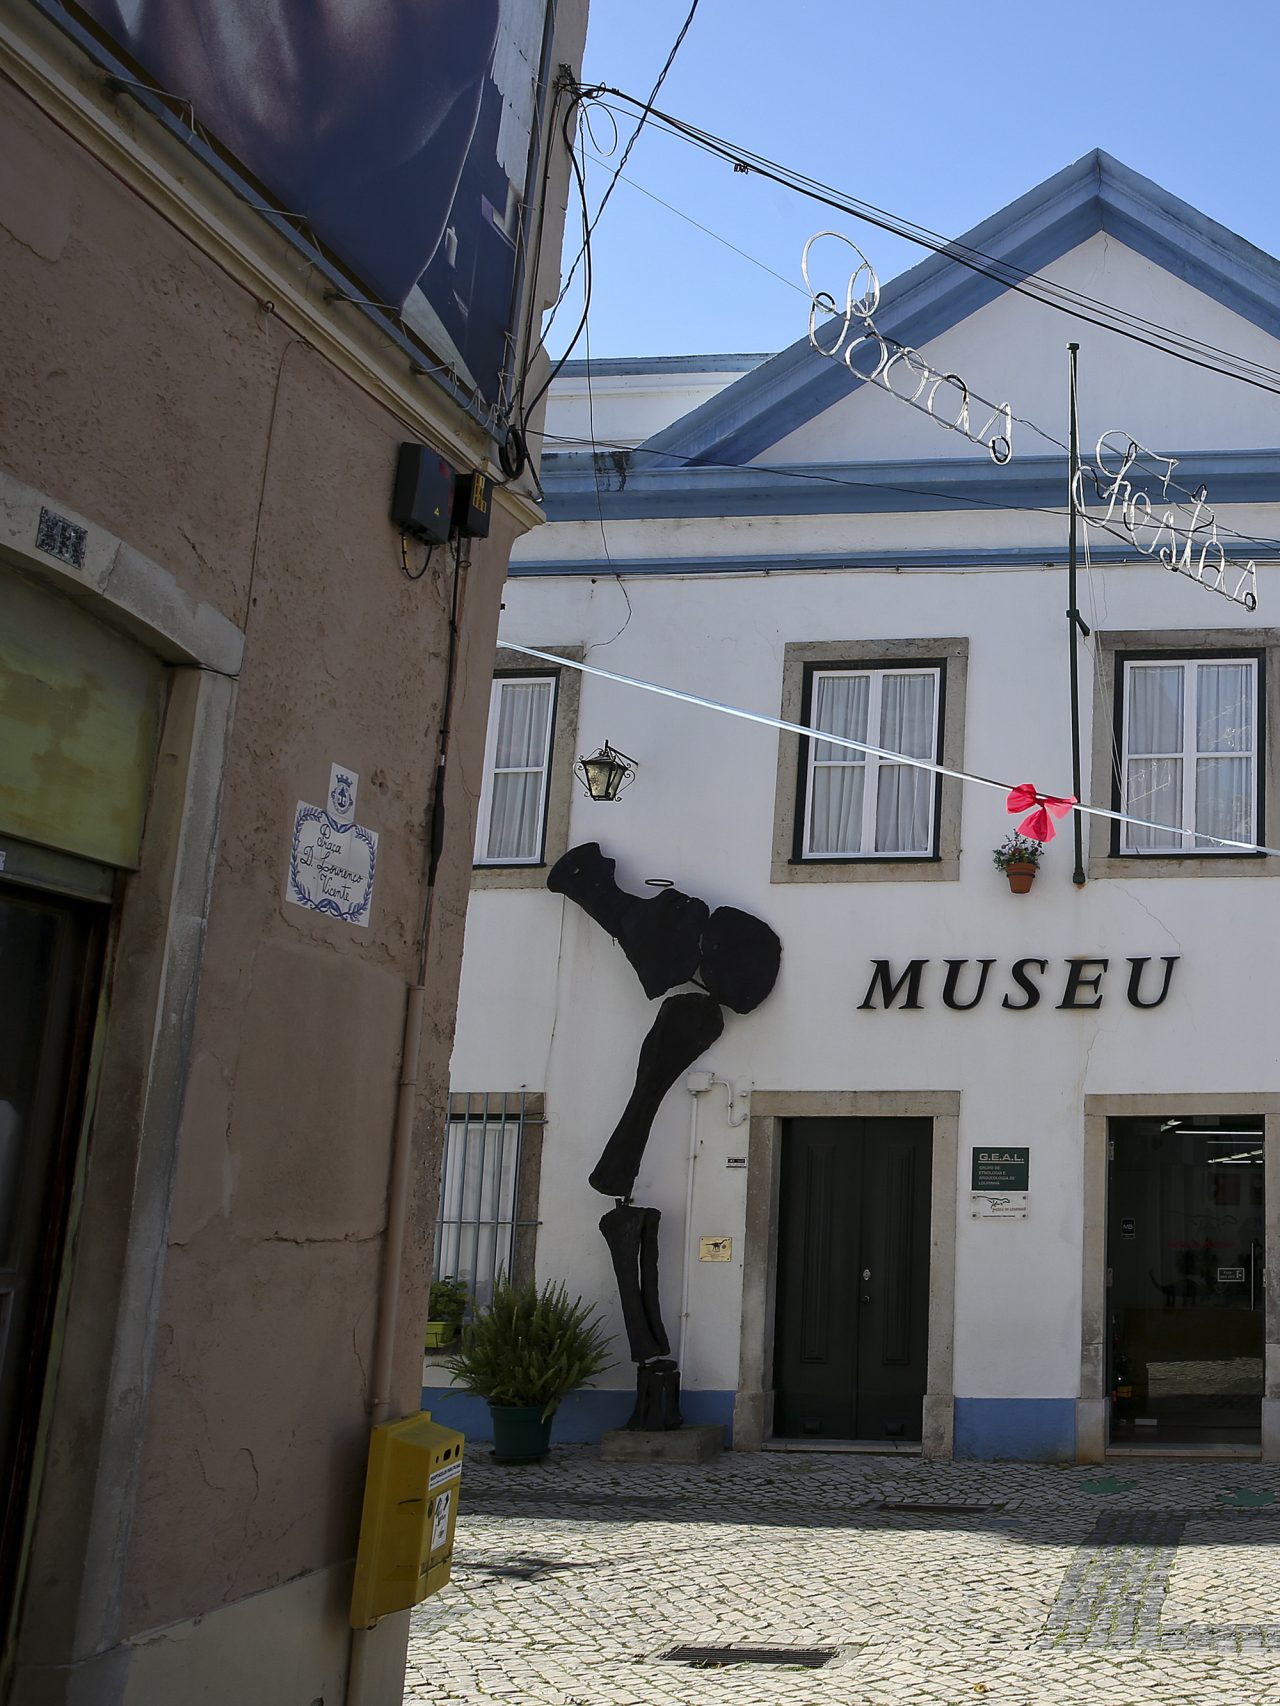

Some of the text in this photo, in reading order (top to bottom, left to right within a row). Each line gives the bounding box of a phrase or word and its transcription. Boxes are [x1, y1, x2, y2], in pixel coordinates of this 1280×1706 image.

[316, 823, 343, 855] Praça
[299, 845, 364, 884] D. Lourenço
[319, 873, 352, 902] Vicente
[856, 956, 1181, 1011] MUSEU
[979, 1153, 1024, 1161] G.E.A.L.
